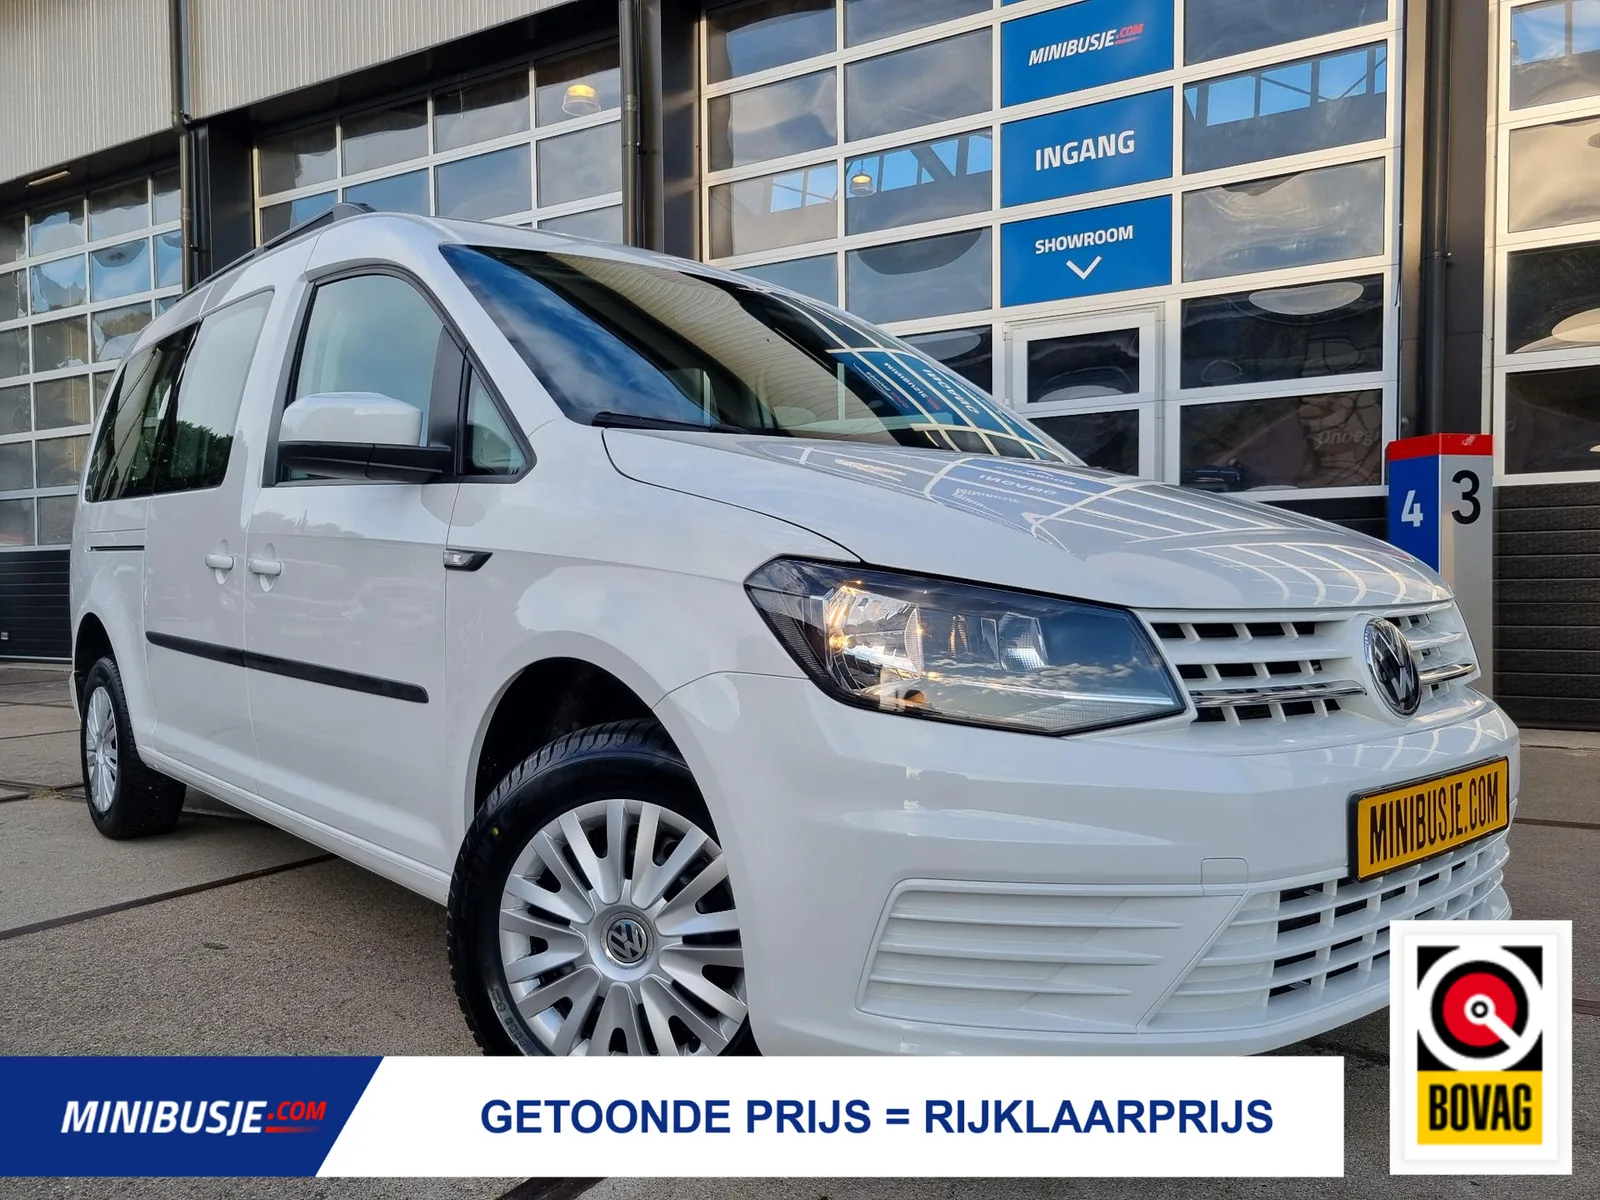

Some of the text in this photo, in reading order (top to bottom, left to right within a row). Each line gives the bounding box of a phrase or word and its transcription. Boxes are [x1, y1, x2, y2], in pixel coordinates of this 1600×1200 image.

[1028, 22, 1144, 66] MINIBUSJE.COM
[1035, 129, 1135, 171] INGANG
[1035, 225, 1134, 255] SHOWROOM
[1401, 490, 1423, 527] 4
[1451, 469, 1481, 525] 3
[1369, 771, 1499, 865] MINIBUSJE.COM
